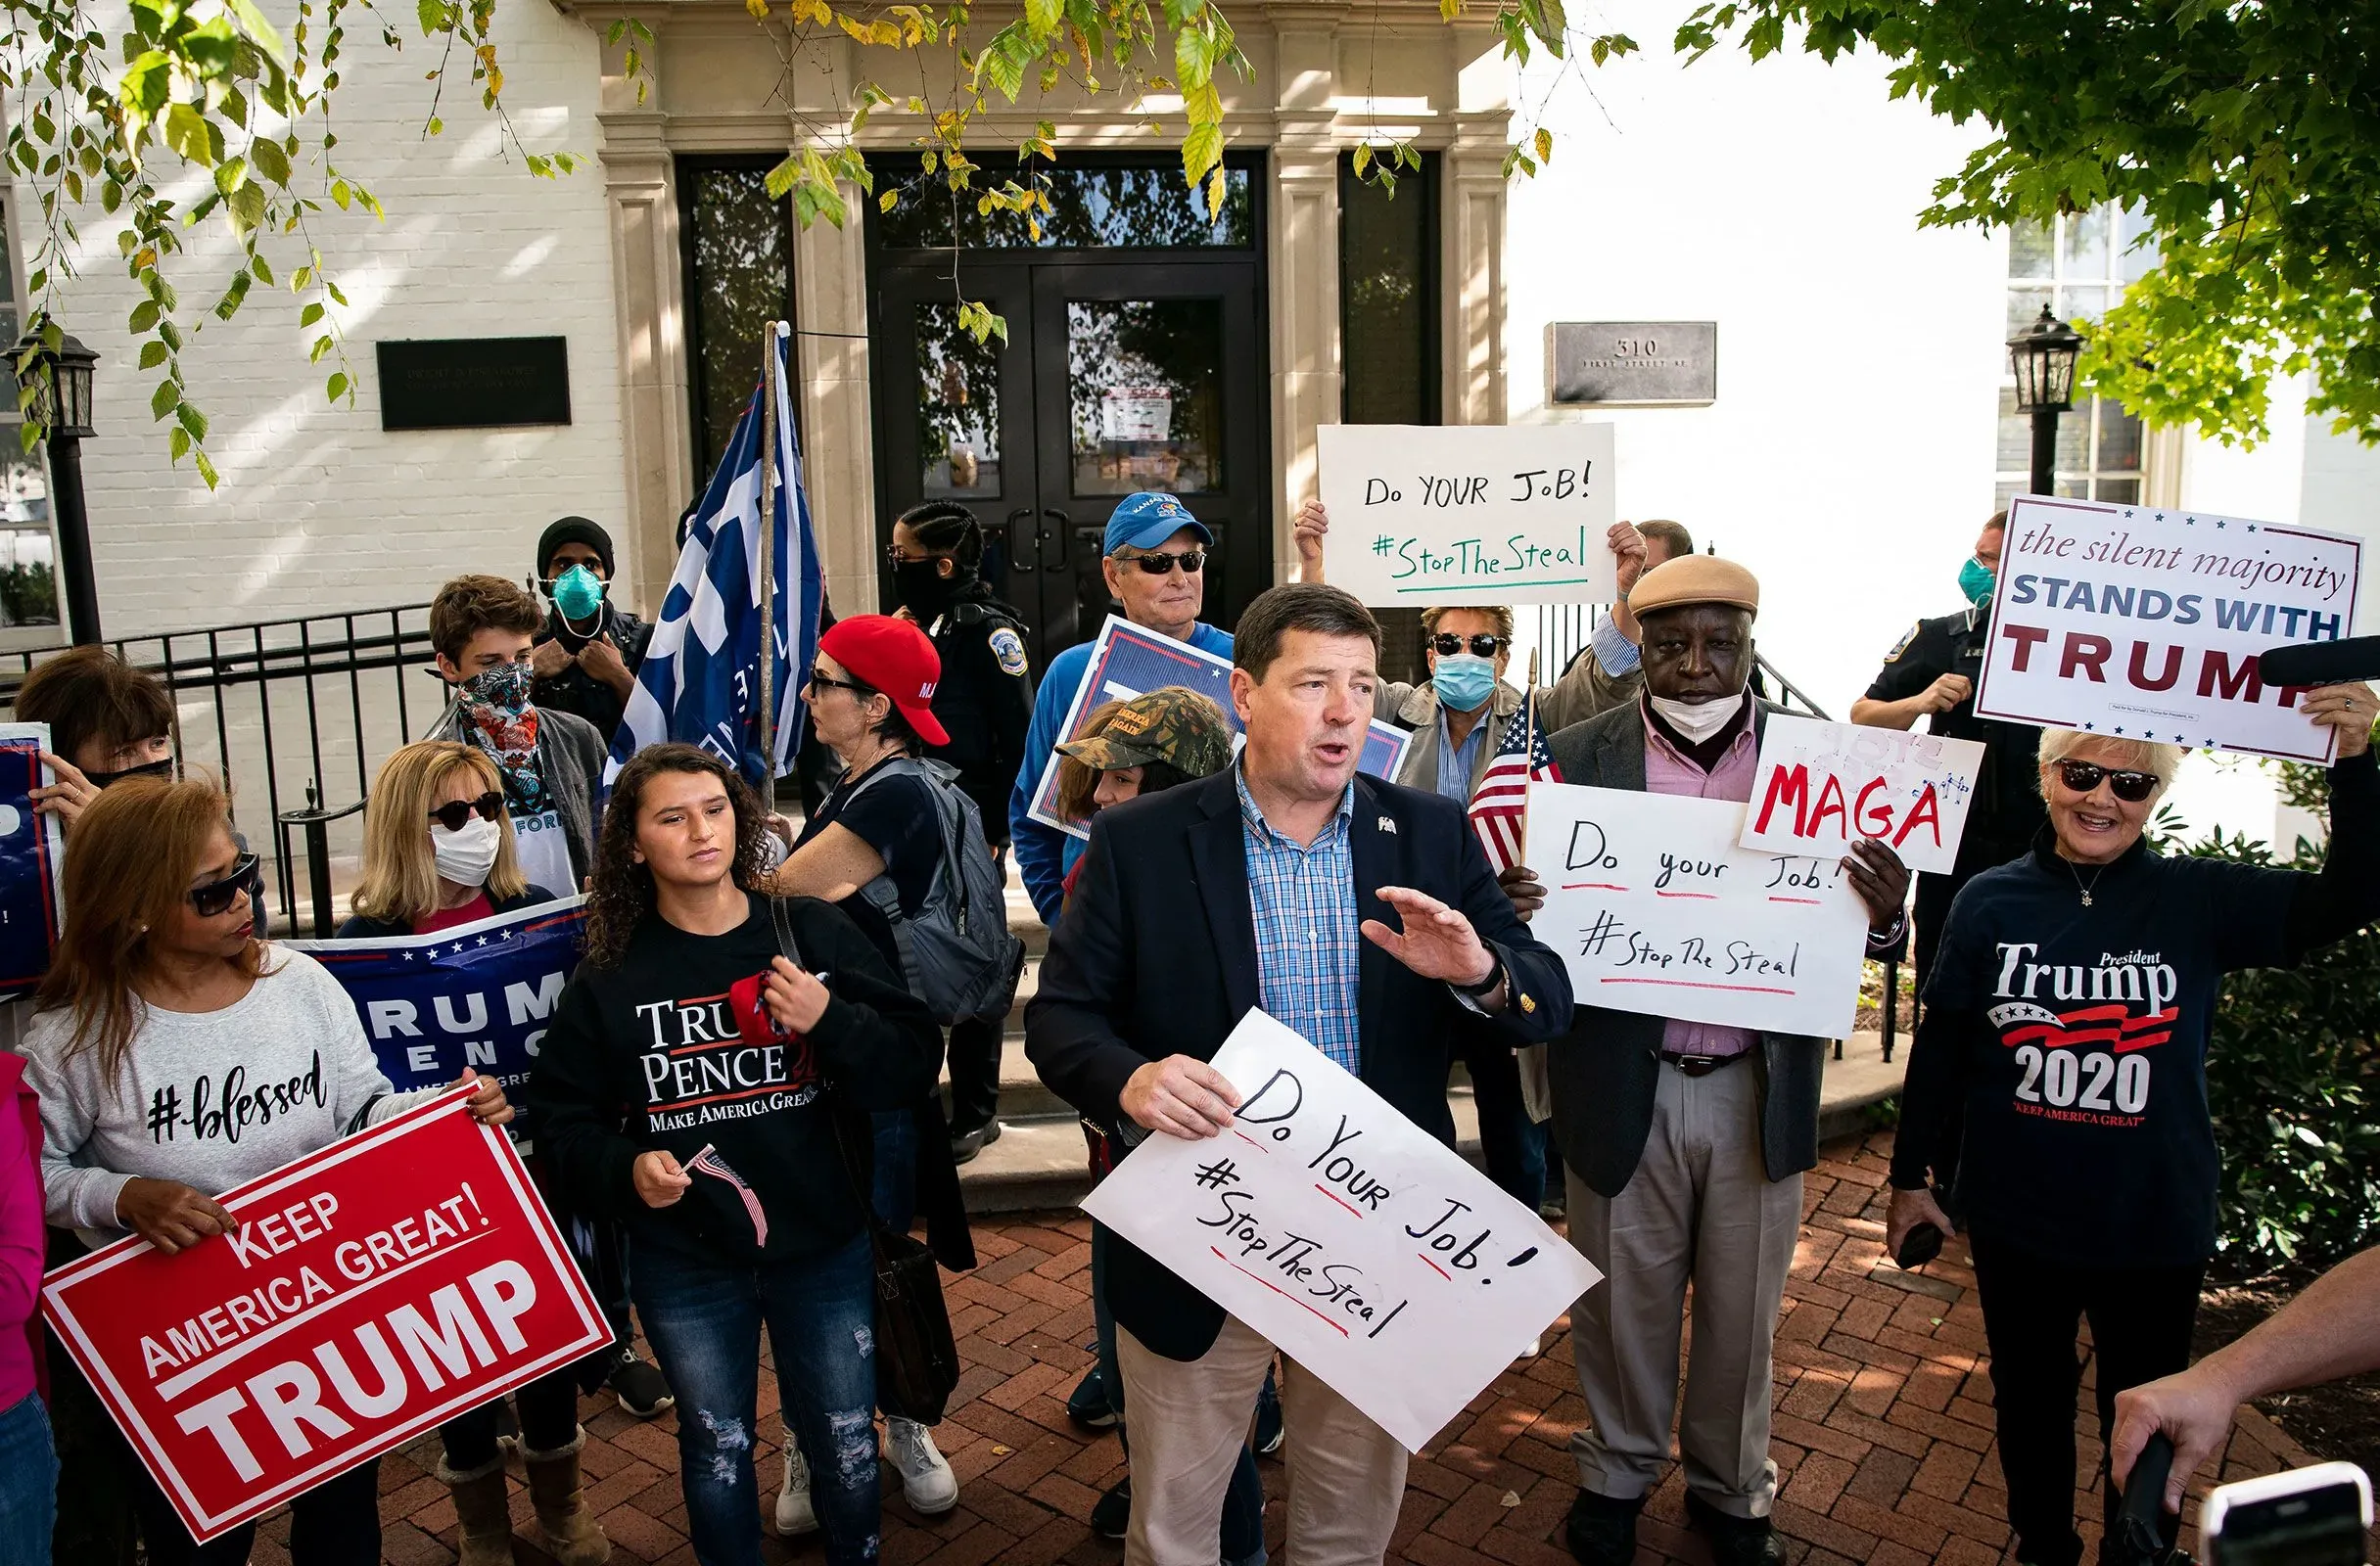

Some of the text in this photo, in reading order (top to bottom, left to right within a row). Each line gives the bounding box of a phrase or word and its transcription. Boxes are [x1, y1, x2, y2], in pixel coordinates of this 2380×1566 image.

[1613, 340, 1657, 358] 310
[1364, 477, 1402, 507] Do
[1418, 475, 1489, 508] YOUR
[2019, 524, 2347, 601] the silent majority
[2011, 575, 2341, 641] STANDS WITH
[1753, 762, 1942, 850] MAGA
[1565, 820, 1619, 872] Do
[1655, 852, 1729, 888] your
[1992, 943, 2177, 1018] Trump
[2100, 949, 2161, 967] President
[367, 971, 566, 1039] RUM
[635, 999, 741, 1049] TRU
[406, 1030, 547, 1072] ENC
[639, 1045, 787, 1103] PENCE
[2015, 1045, 2151, 1114] 2020
[148, 1049, 328, 1143] #blessed
[649, 1111, 696, 1132] MAKE
[698, 1099, 769, 1125] AMERICA
[2043, 1107, 2099, 1126] AMERICA
[1234, 1068, 1540, 1286] Do YOUR Job!
[225, 1191, 339, 1268] KEEP
[139, 1181, 492, 1378] AMERICA GREAT!
[174, 1259, 538, 1484] TRUMP
